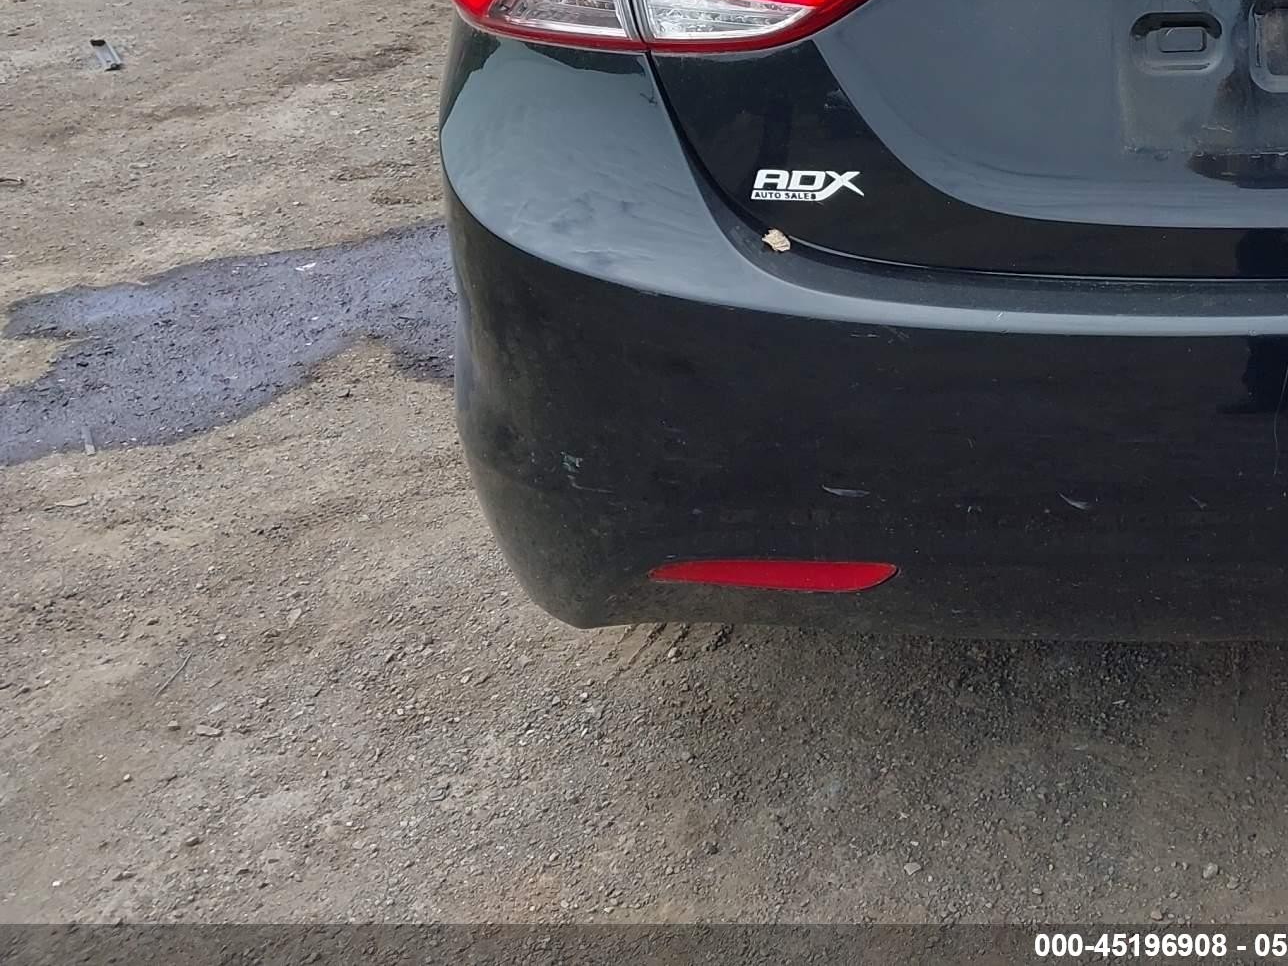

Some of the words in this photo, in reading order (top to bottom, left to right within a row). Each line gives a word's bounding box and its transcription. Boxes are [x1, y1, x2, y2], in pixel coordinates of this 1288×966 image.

[753, 169, 865, 198] ADX
[754, 191, 781, 199] AUTO
[785, 192, 817, 200] SALES
